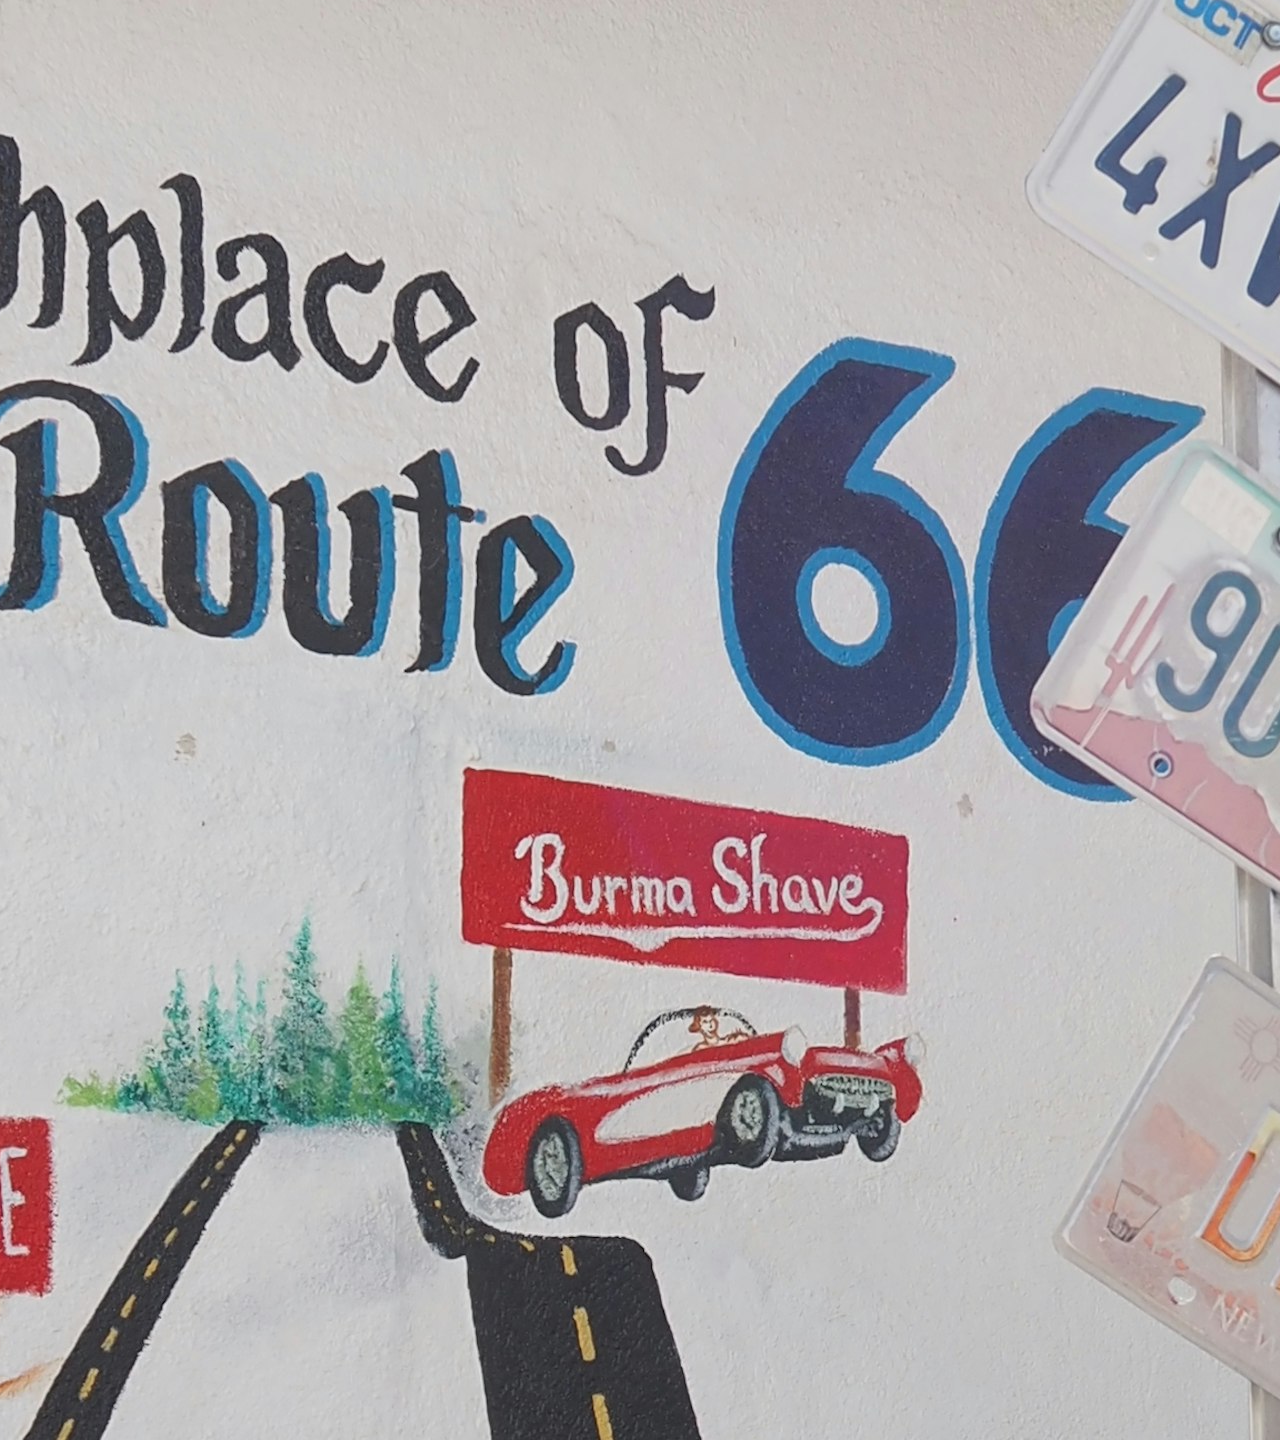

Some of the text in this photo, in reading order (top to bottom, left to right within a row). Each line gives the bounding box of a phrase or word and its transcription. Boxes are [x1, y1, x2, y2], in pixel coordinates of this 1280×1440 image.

[555, 276, 715, 475] of
[719, 337, 1204, 802] 66
[515, 832, 884, 924] Burma Shave
